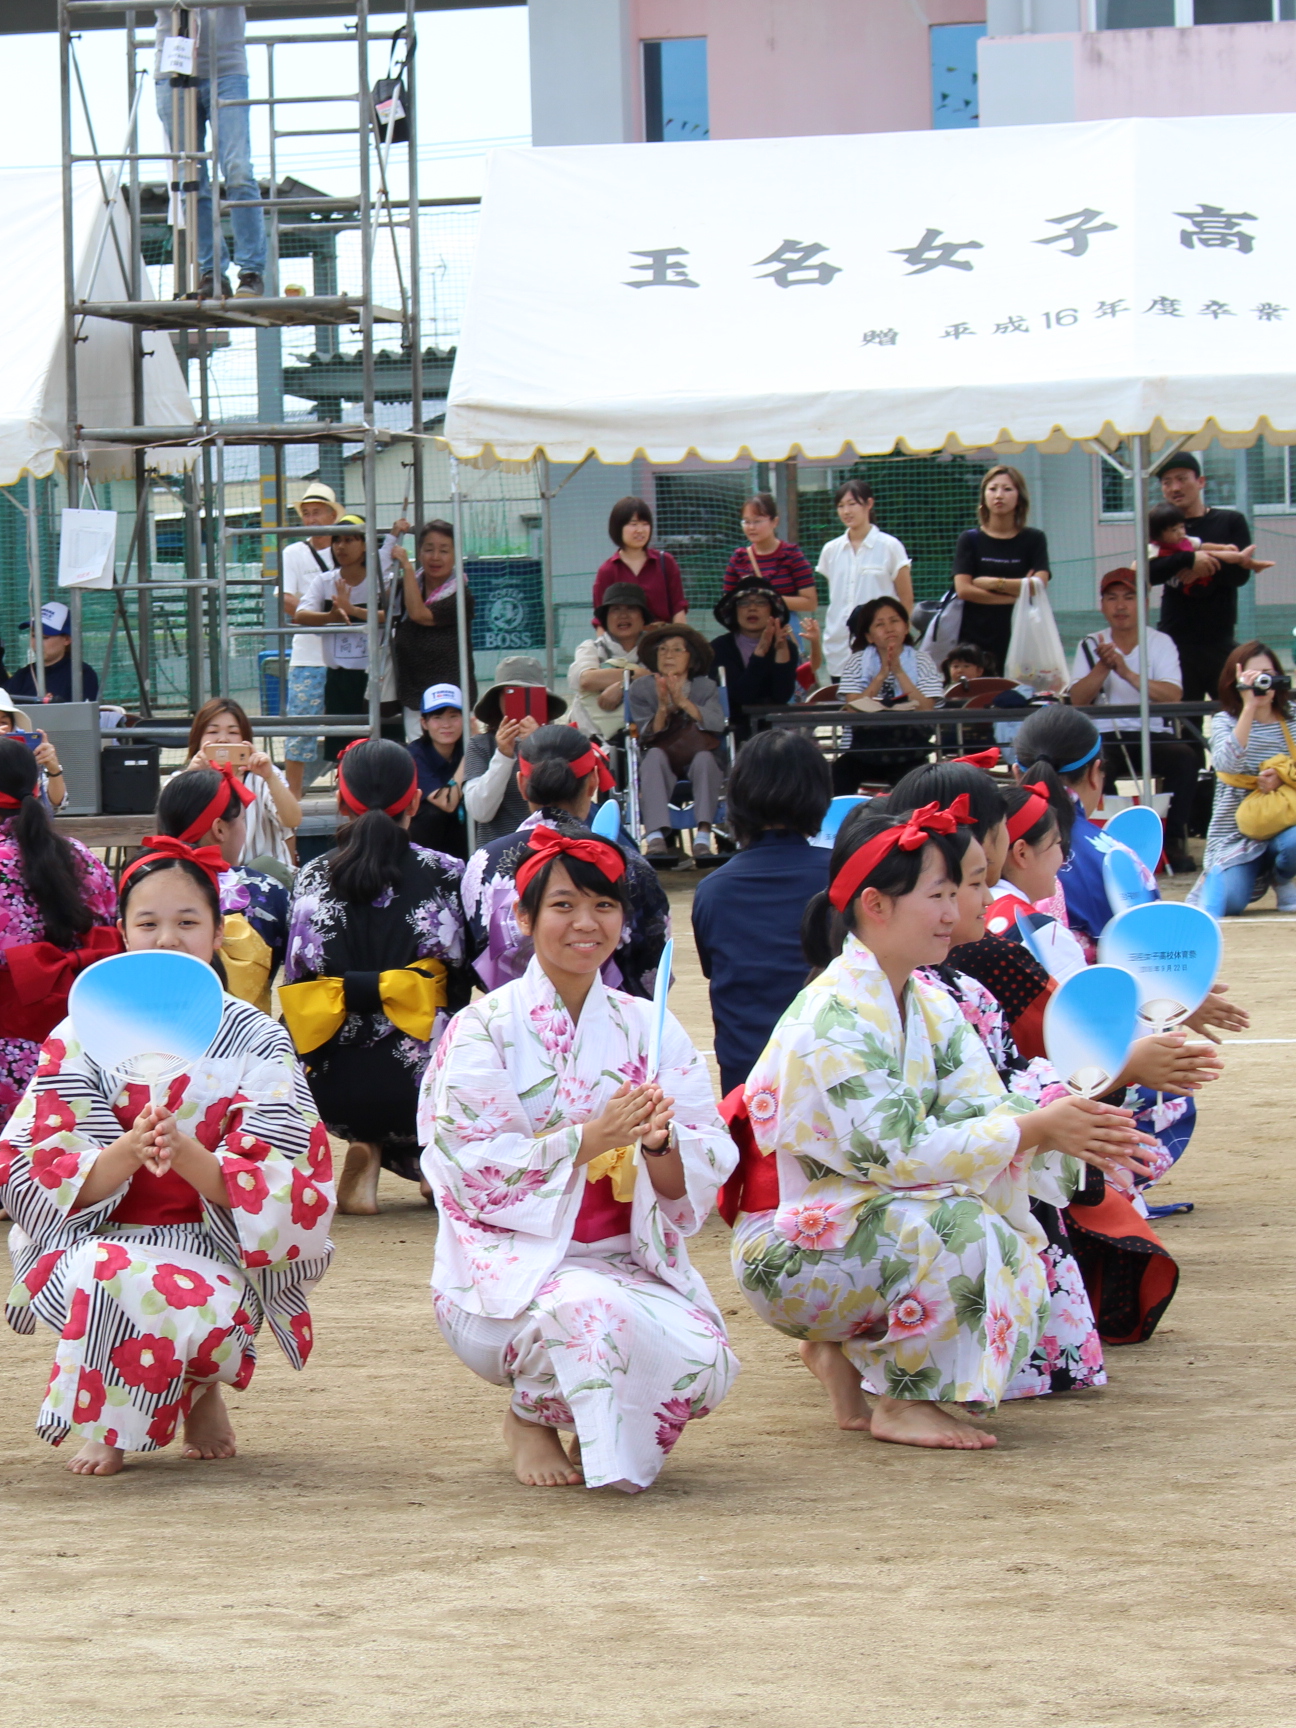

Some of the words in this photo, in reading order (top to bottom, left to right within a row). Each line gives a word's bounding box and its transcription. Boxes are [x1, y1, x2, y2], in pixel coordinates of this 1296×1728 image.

[621, 204, 1259, 290] 玉名女子高
[485, 632, 531, 648] BOSS
